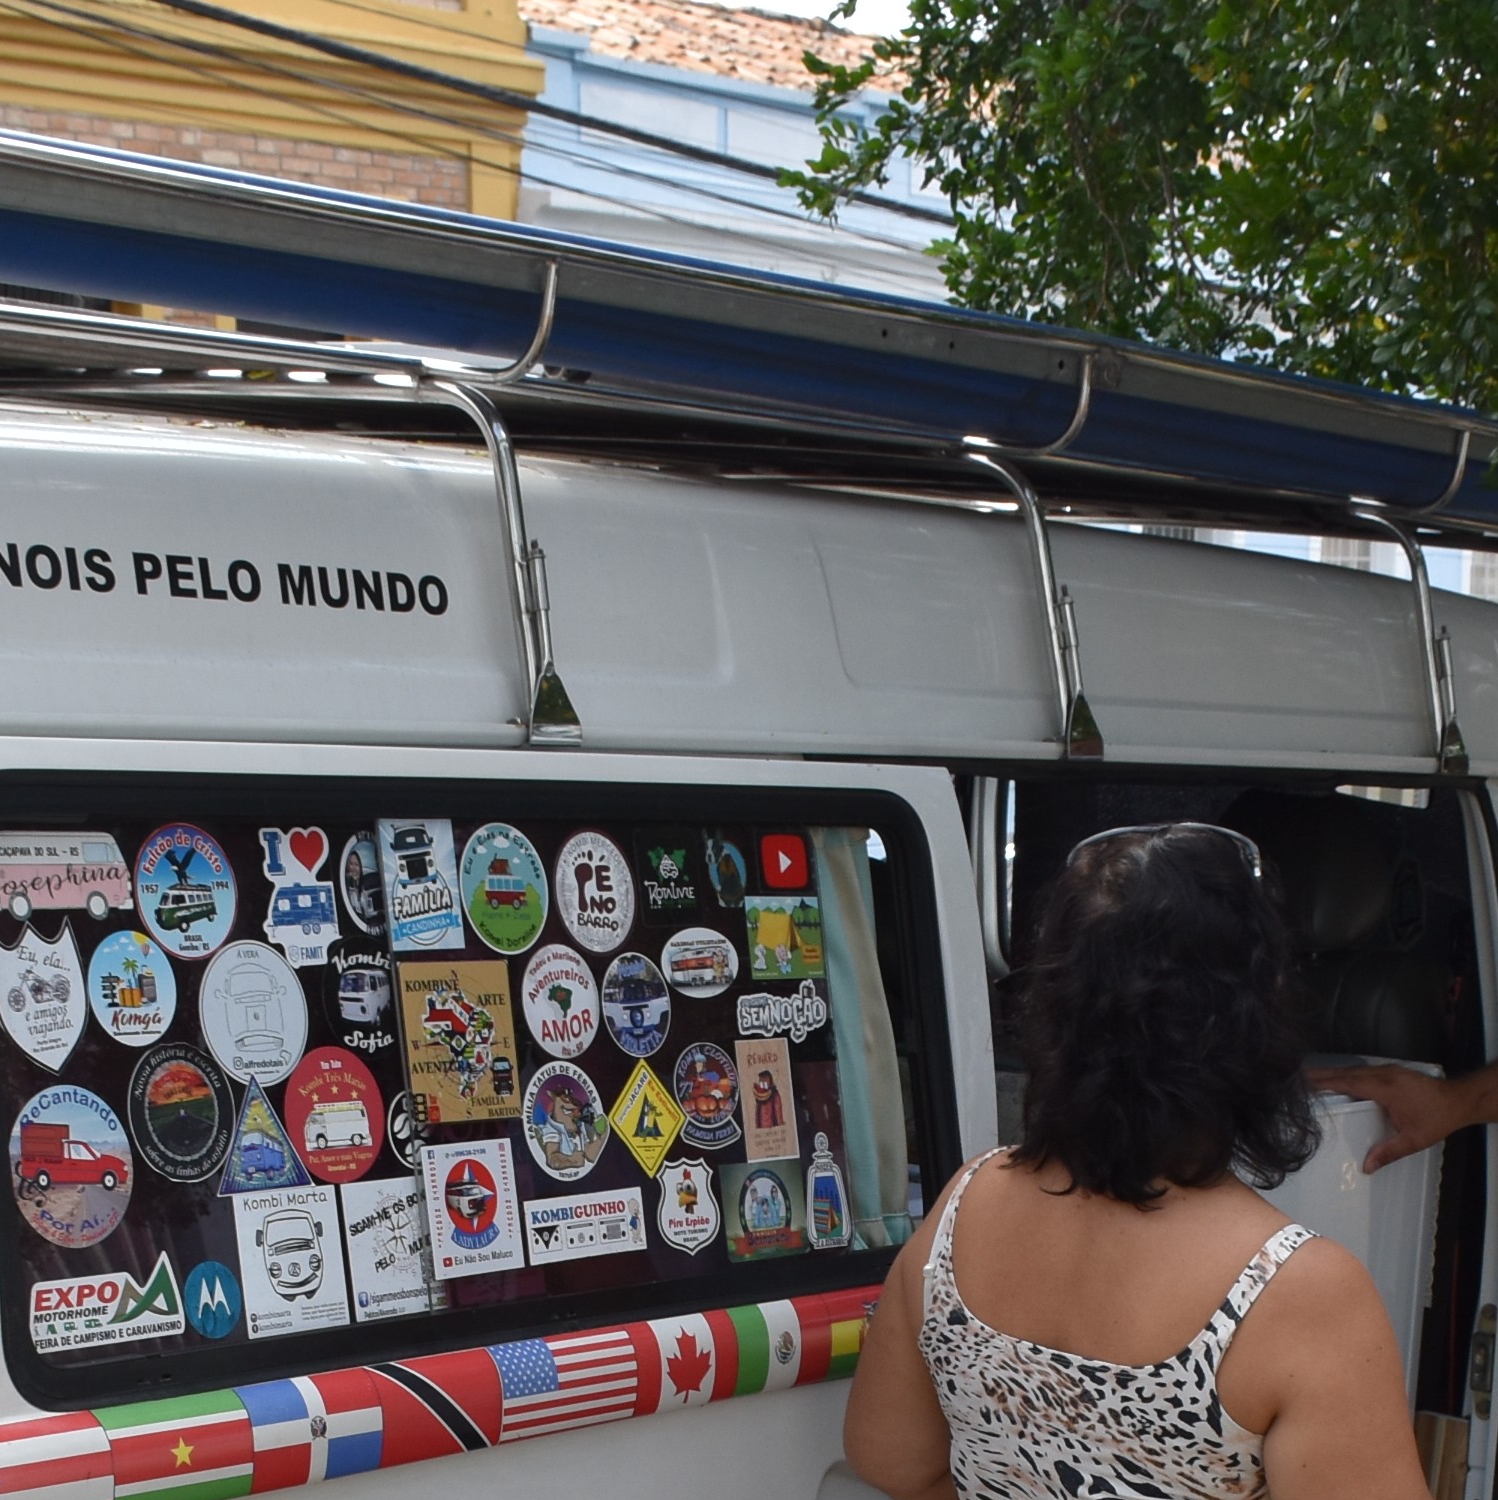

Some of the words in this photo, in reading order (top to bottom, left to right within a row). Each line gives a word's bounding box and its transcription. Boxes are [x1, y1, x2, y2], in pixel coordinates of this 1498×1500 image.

[132, 551, 261, 602] PELO
[278, 562, 450, 616] MUNDO
[143, 834, 174, 876] Falcão
[176, 828, 191, 847] de
[193, 836, 224, 875] Cristo
[140, 883, 160, 895] 1957
[211, 881, 230, 891] 1994
[393, 885, 454, 921] FAMÍLIA
[590, 894, 617, 915] NO
[406, 916, 447, 935] CANDINHA
[577, 912, 620, 932] BARRO
[301, 946, 324, 961] FAMIT
[330, 946, 392, 973] Kombi
[528, 968, 591, 1004] Aventureiros
[477, 992, 506, 1007] ARTE
[33, 1004, 68, 1023] amigos
[541, 1008, 594, 1043] AMOR
[343, 1029, 395, 1054] Sofia
[533, 1065, 558, 1088] TATUS
[560, 1065, 572, 1075] DE
[488, 1106, 522, 1118] BARTON
[243, 1193, 284, 1212] Kombi
[287, 1190, 328, 1207] Marta
[531, 1199, 626, 1225] KOMBIGUINHO
[374, 1253, 396, 1273] PELO
[454, 1256, 464, 1266] Eu
[478, 1252, 491, 1263] Sou
[491, 1249, 514, 1261] Maluco
[33, 1280, 120, 1313] EXPO
[33, 1305, 110, 1325] MOTORHOME
[35, 1336, 59, 1351] FEIRA
[60, 1335, 73, 1346] DE
[73, 1330, 117, 1345] CAMPISMO
[119, 1329, 125, 1338] E
[125, 1320, 182, 1338] CARAVANISMO
